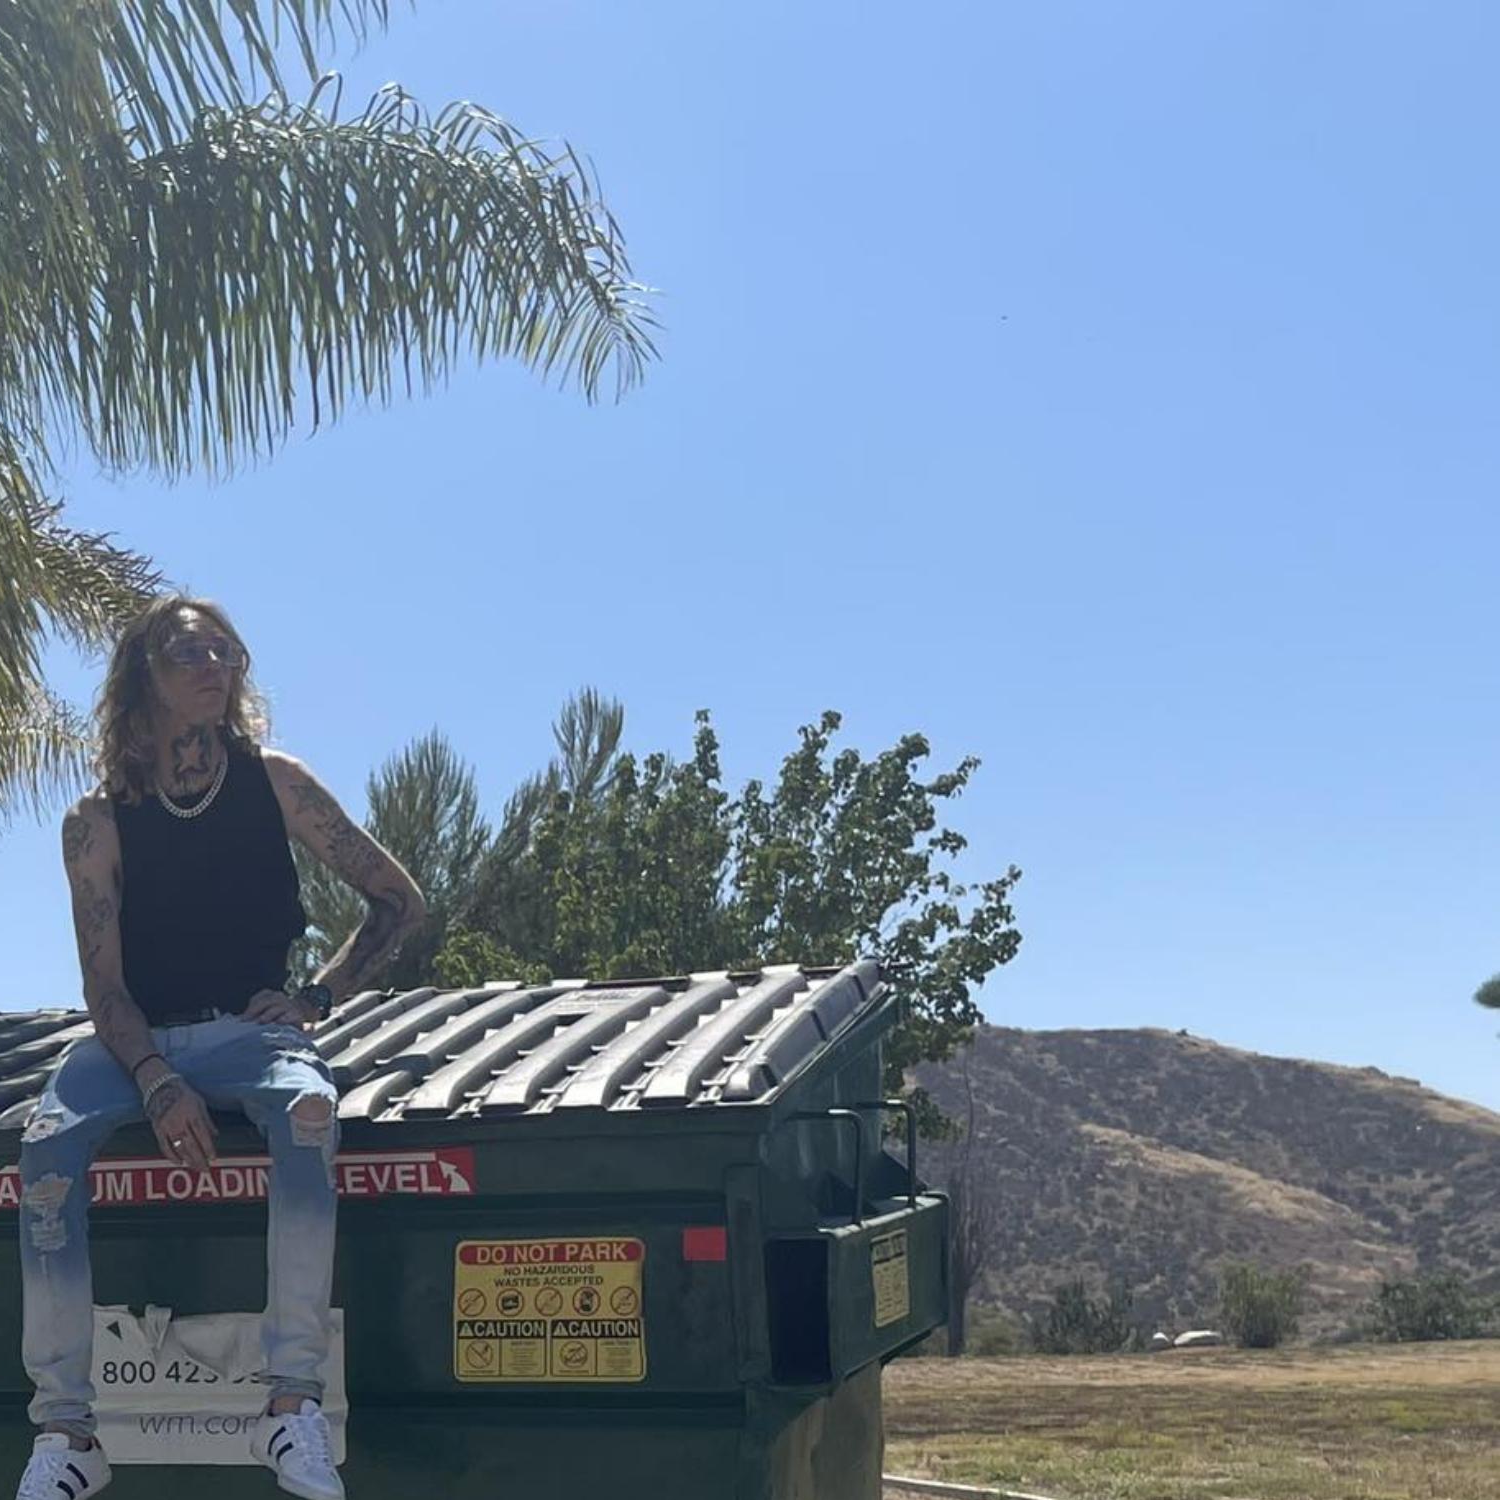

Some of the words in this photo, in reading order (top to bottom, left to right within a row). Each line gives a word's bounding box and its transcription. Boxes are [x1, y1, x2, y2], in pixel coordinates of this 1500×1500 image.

[145, 1167, 270, 1200] LOADIN
[336, 1163, 442, 1194] EVEL
[476, 1246, 507, 1263] DO
[513, 1244, 559, 1262] NOT
[565, 1243, 628, 1261] PARK
[504, 1266, 521, 1276] NO
[523, 1264, 595, 1275] HAZARDOUS
[494, 1277, 540, 1287] WASTES
[544, 1275, 604, 1286] ACCEPTED
[474, 1321, 544, 1337] CAUTION
[568, 1321, 639, 1337] CAUTION
[103, 1361, 155, 1384] 800
